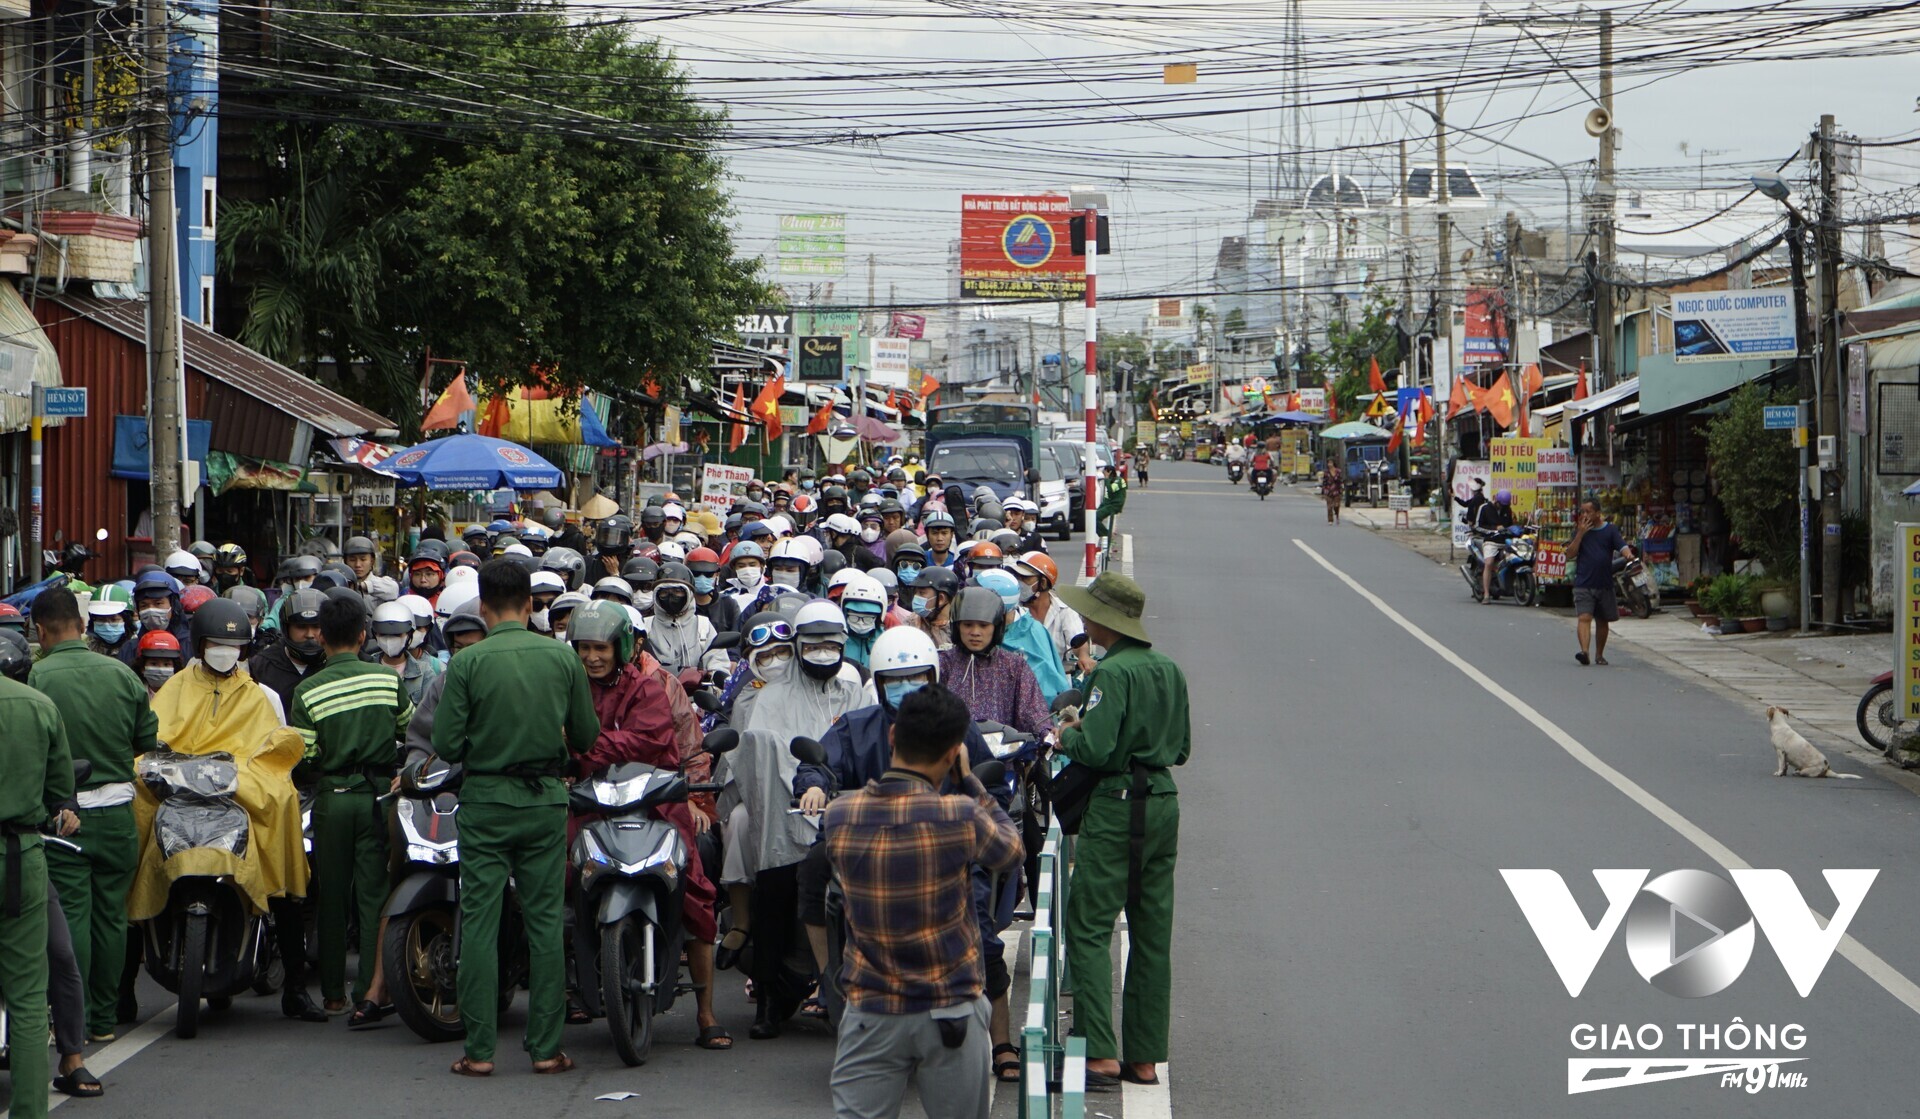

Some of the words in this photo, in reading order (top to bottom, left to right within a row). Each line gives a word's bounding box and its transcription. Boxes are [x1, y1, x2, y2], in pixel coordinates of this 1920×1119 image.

[977, 198, 992, 211] PHÁT
[1678, 300, 1704, 315] NGỌC
[1706, 295, 1732, 311] QUỐC
[1734, 295, 1787, 310] COMPUTER
[804, 338, 837, 357] Quán
[802, 357, 840, 376] CHAY
[67, 391, 79, 403] SỐ
[80, 393, 84, 403] 7
[1492, 442, 1507, 457] HỦ
[1510, 441, 1533, 457] TIẾU
[1456, 465, 1482, 475] LONG
[1517, 462, 1536, 473] NUI
[1536, 563, 1547, 573] XE
[1548, 562, 1566, 575] MÁY
[578, 610, 600, 619] Grab
